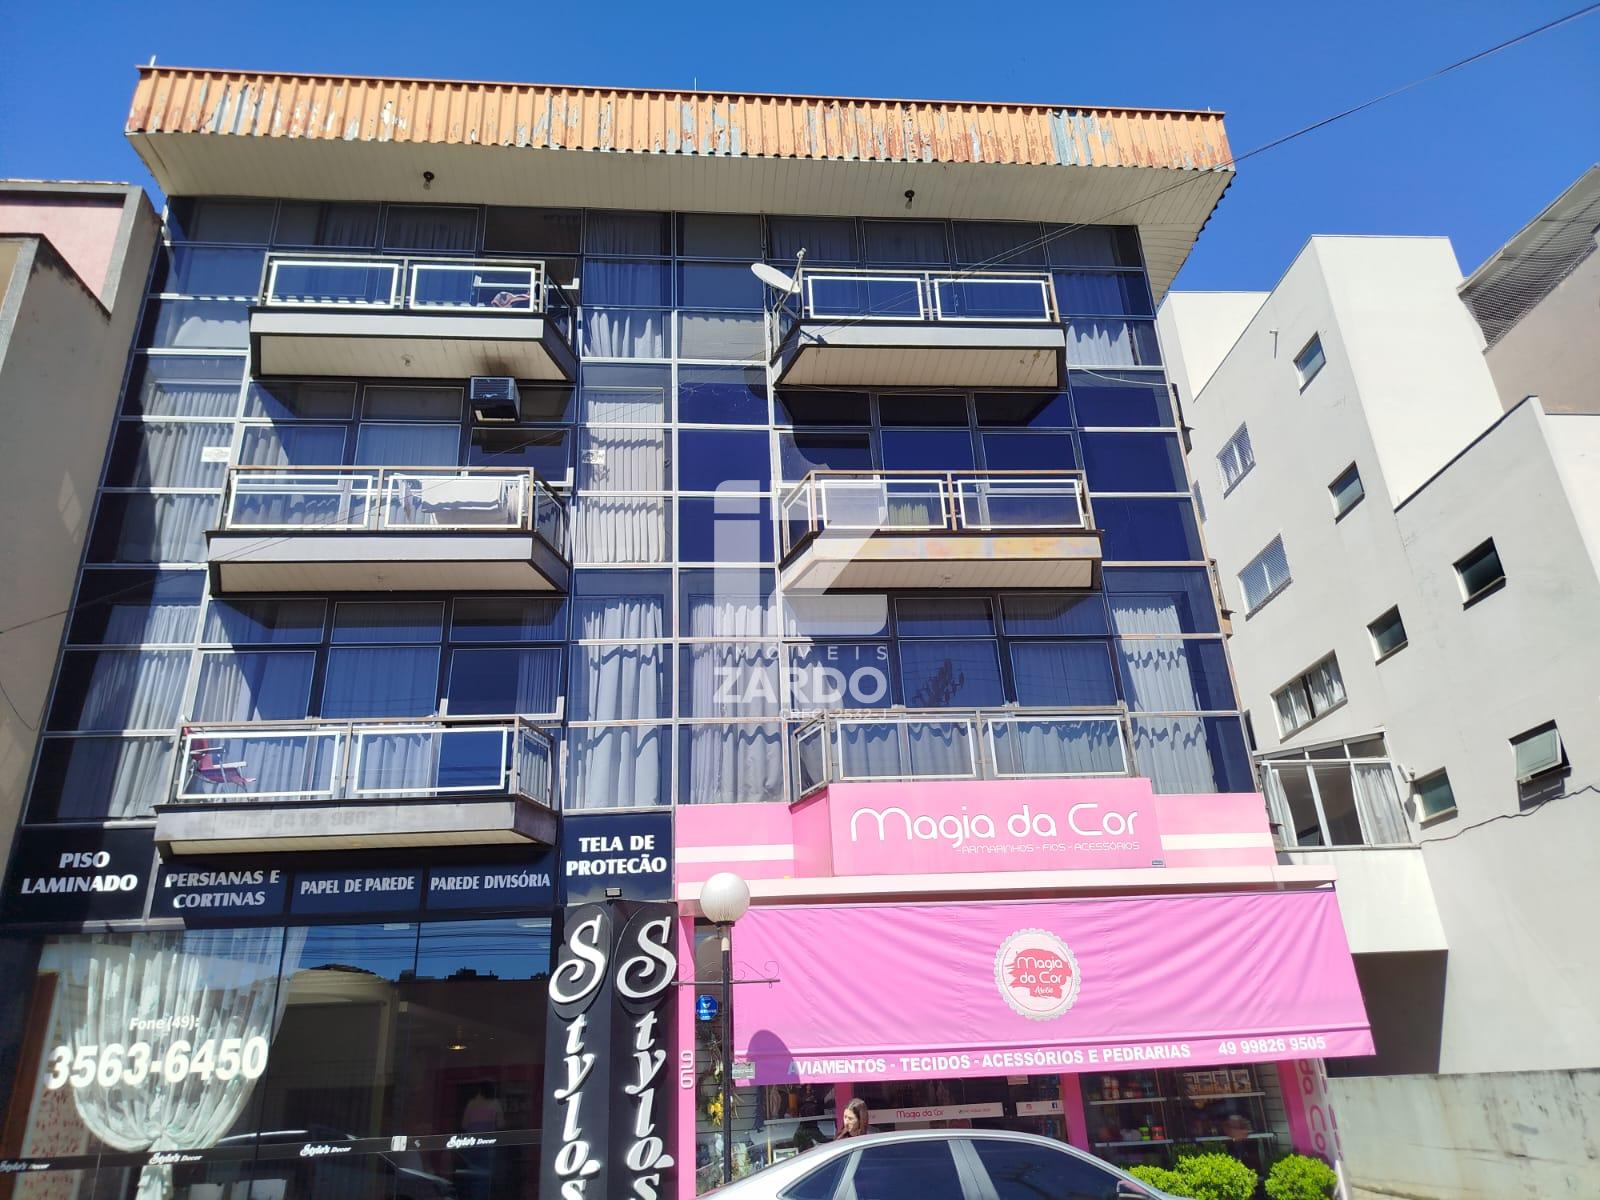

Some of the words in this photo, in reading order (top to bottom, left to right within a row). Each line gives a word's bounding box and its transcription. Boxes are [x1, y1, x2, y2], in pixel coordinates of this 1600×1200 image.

[849, 805, 996, 849] Magia
[1007, 803, 1057, 837] da
[1067, 802, 1139, 836] Cor
[579, 836, 624, 853] TELA
[629, 834, 655, 851] DE
[1042, 842, 1066, 852] FIOS
[59, 851, 110, 868] PISO
[21, 873, 138, 894] LAMINADO
[164, 871, 264, 888] PERSIANAS
[269, 869, 281, 884] E
[300, 879, 340, 895] PAPEL
[344, 878, 363, 893] DE
[364, 876, 415, 892] PAREDE
[430, 875, 480, 891] PAREDE
[484, 870, 551, 889] DIVISÓRIA
[173, 891, 266, 909] CORTINAS
[1017, 956, 1063, 971] Magia
[1020, 971, 1036, 984] da
[1039, 971, 1062, 984] Cor
[129, 1017, 165, 1031] Fone
[46, 1036, 268, 1090] 3563-6450
[788, 1058, 886, 1076] AVIAMENTOS
[900, 1055, 971, 1072] TECIDOS
[982, 1049, 1084, 1068] ACESSÓRIOS
[1088, 1050, 1099, 1063] E
[1103, 1044, 1191, 1062] PEDRARIAS
[1218, 1040, 1237, 1055] 49
[1240, 1038, 1286, 1054] 99826
[1289, 1035, 1326, 1051] 9505
